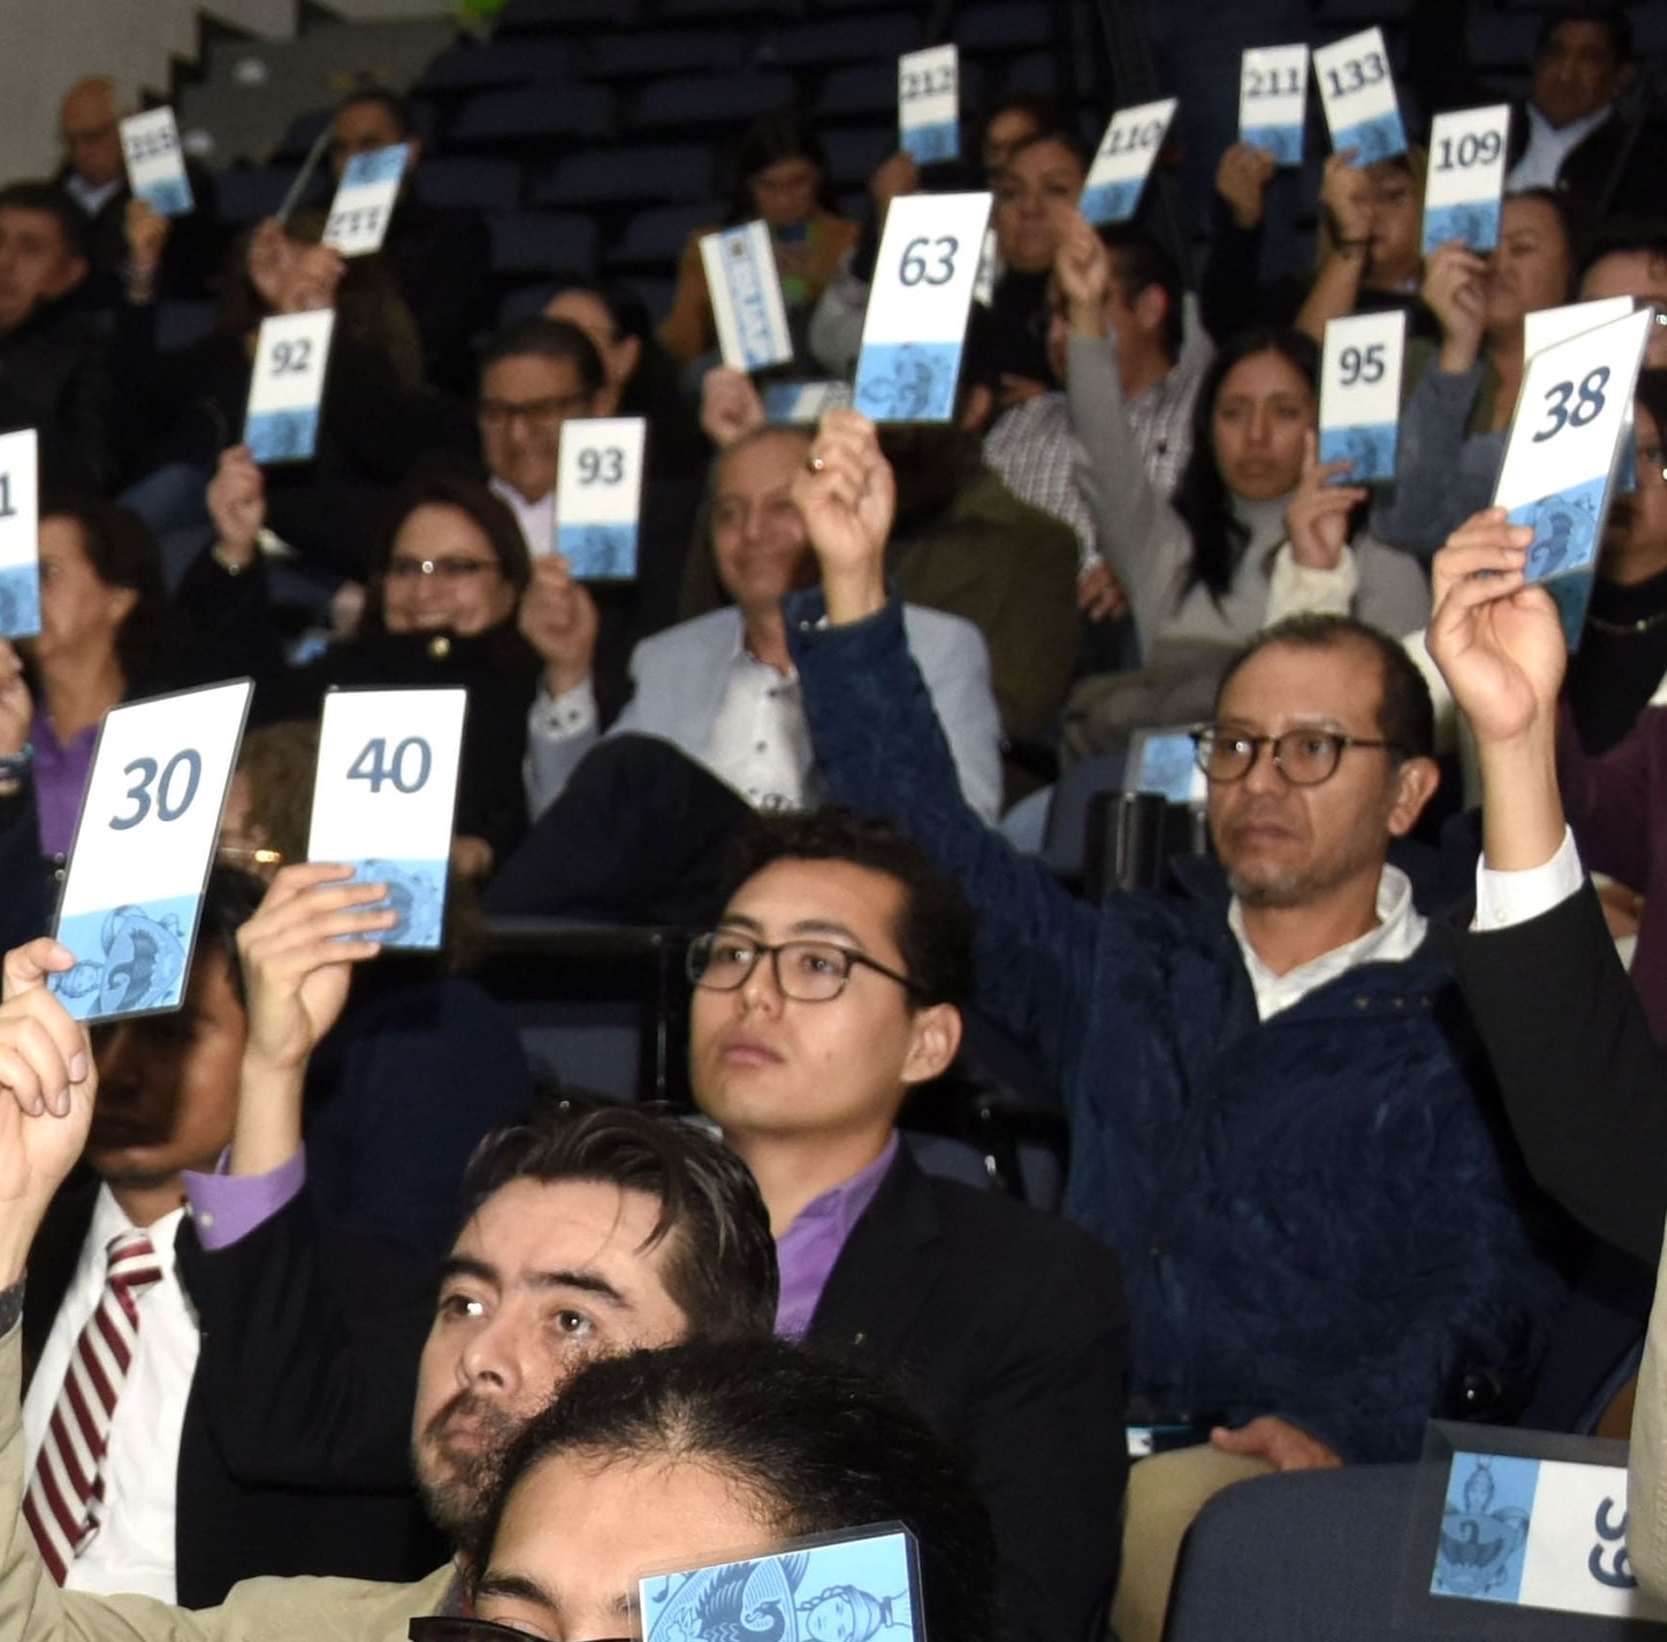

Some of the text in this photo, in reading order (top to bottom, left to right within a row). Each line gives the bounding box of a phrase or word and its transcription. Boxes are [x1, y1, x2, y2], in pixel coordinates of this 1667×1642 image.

[1246, 70, 1300, 98] 211
[1326, 52, 1386, 98] 133
[1104, 120, 1164, 158] 110
[1436, 131, 1501, 172] 109
[898, 236, 958, 287] 63
[271, 338, 312, 377] 92
[1340, 345, 1385, 387] 95
[1531, 366, 1611, 444] 38
[576, 448, 624, 486] 93
[347, 736, 432, 794] 40
[108, 748, 202, 832] 30
